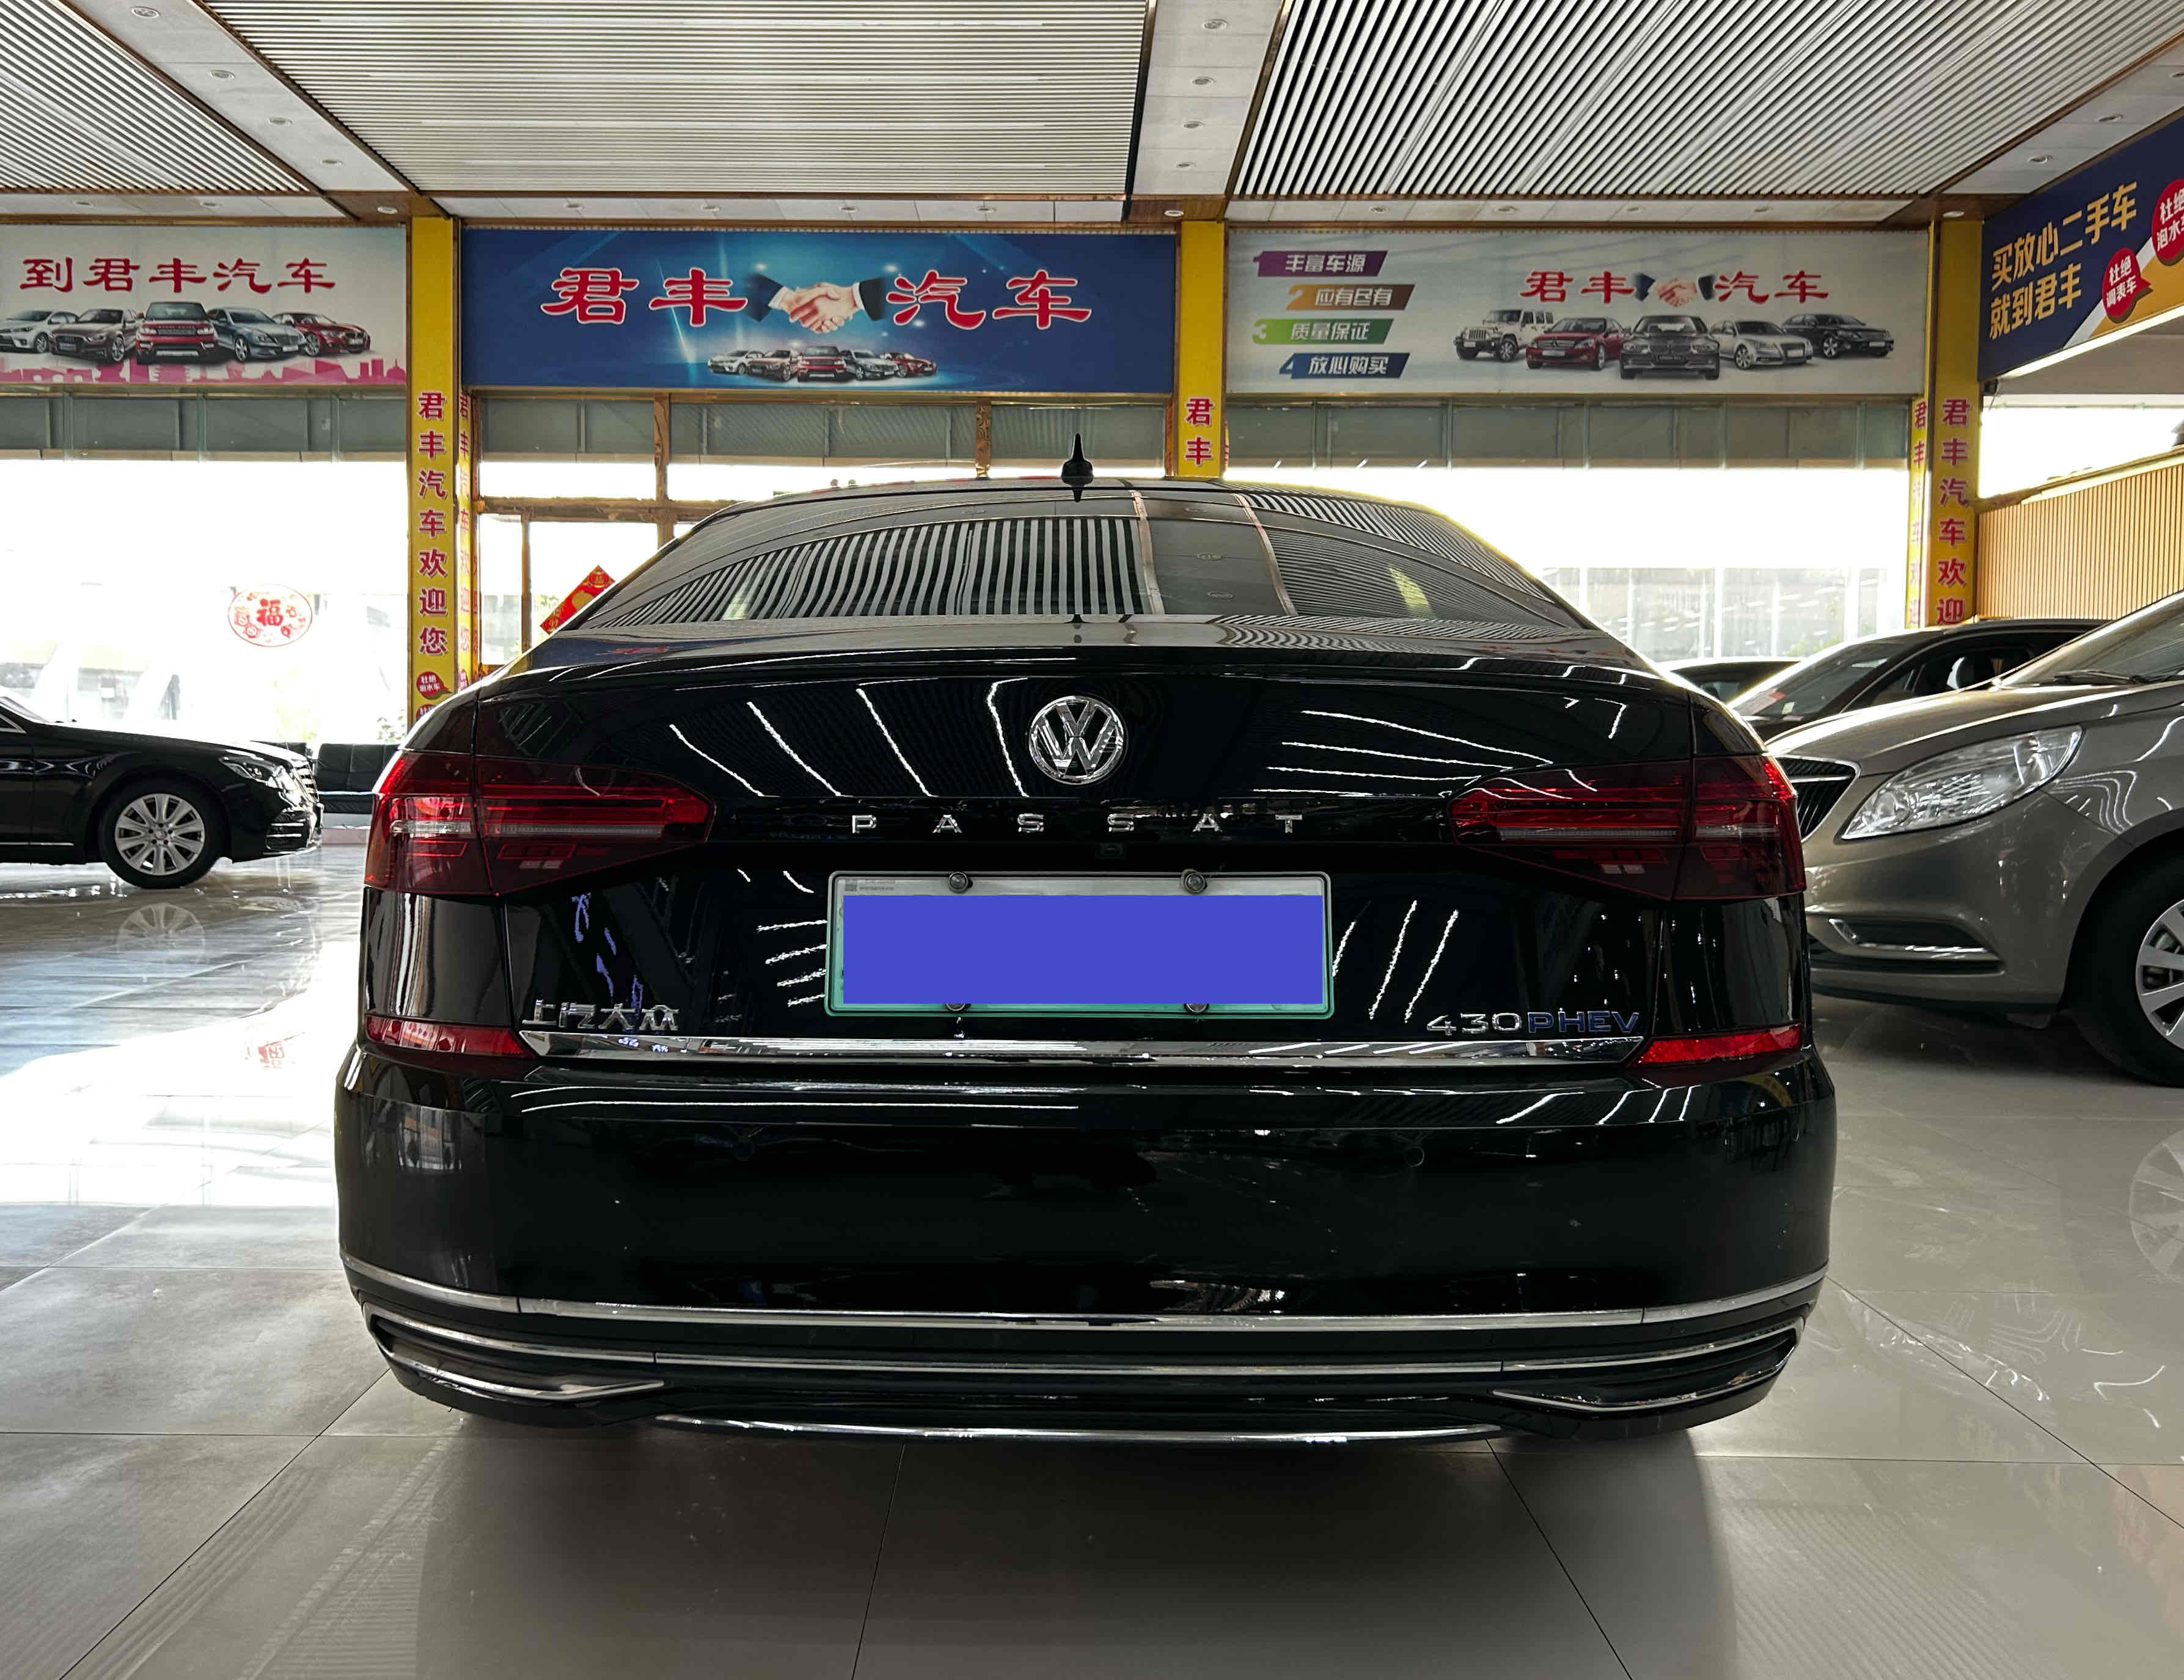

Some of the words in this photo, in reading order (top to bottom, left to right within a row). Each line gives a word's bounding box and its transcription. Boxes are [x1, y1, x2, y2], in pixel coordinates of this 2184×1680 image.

[1991, 181, 2137, 290] 买放心二手车
[2157, 215, 2184, 252] 泡水
[20, 257, 335, 293] 到君丰汽车
[1286, 254, 1366, 272] 丰富车源
[2109, 255, 2132, 287] 杜绝
[540, 267, 748, 327] 君丰
[886, 269, 1092, 330] 汽车
[1315, 288, 1393, 306] 应有尽有
[1519, 270, 1636, 304] 君丰
[1713, 270, 1830, 304] 汽车
[1990, 263, 2081, 340] 就到君丰
[2106, 276, 2137, 308] 调表车
[1291, 323, 1370, 341] 质量保证
[1308, 356, 1389, 375] 放心购买
[1185, 397, 1213, 466] 君丰
[417, 392, 447, 655] 君丰汽车欢迎您
[1936, 399, 1971, 626] 君丰汽车欢迎
[851, 813, 1303, 835] PASSAT
